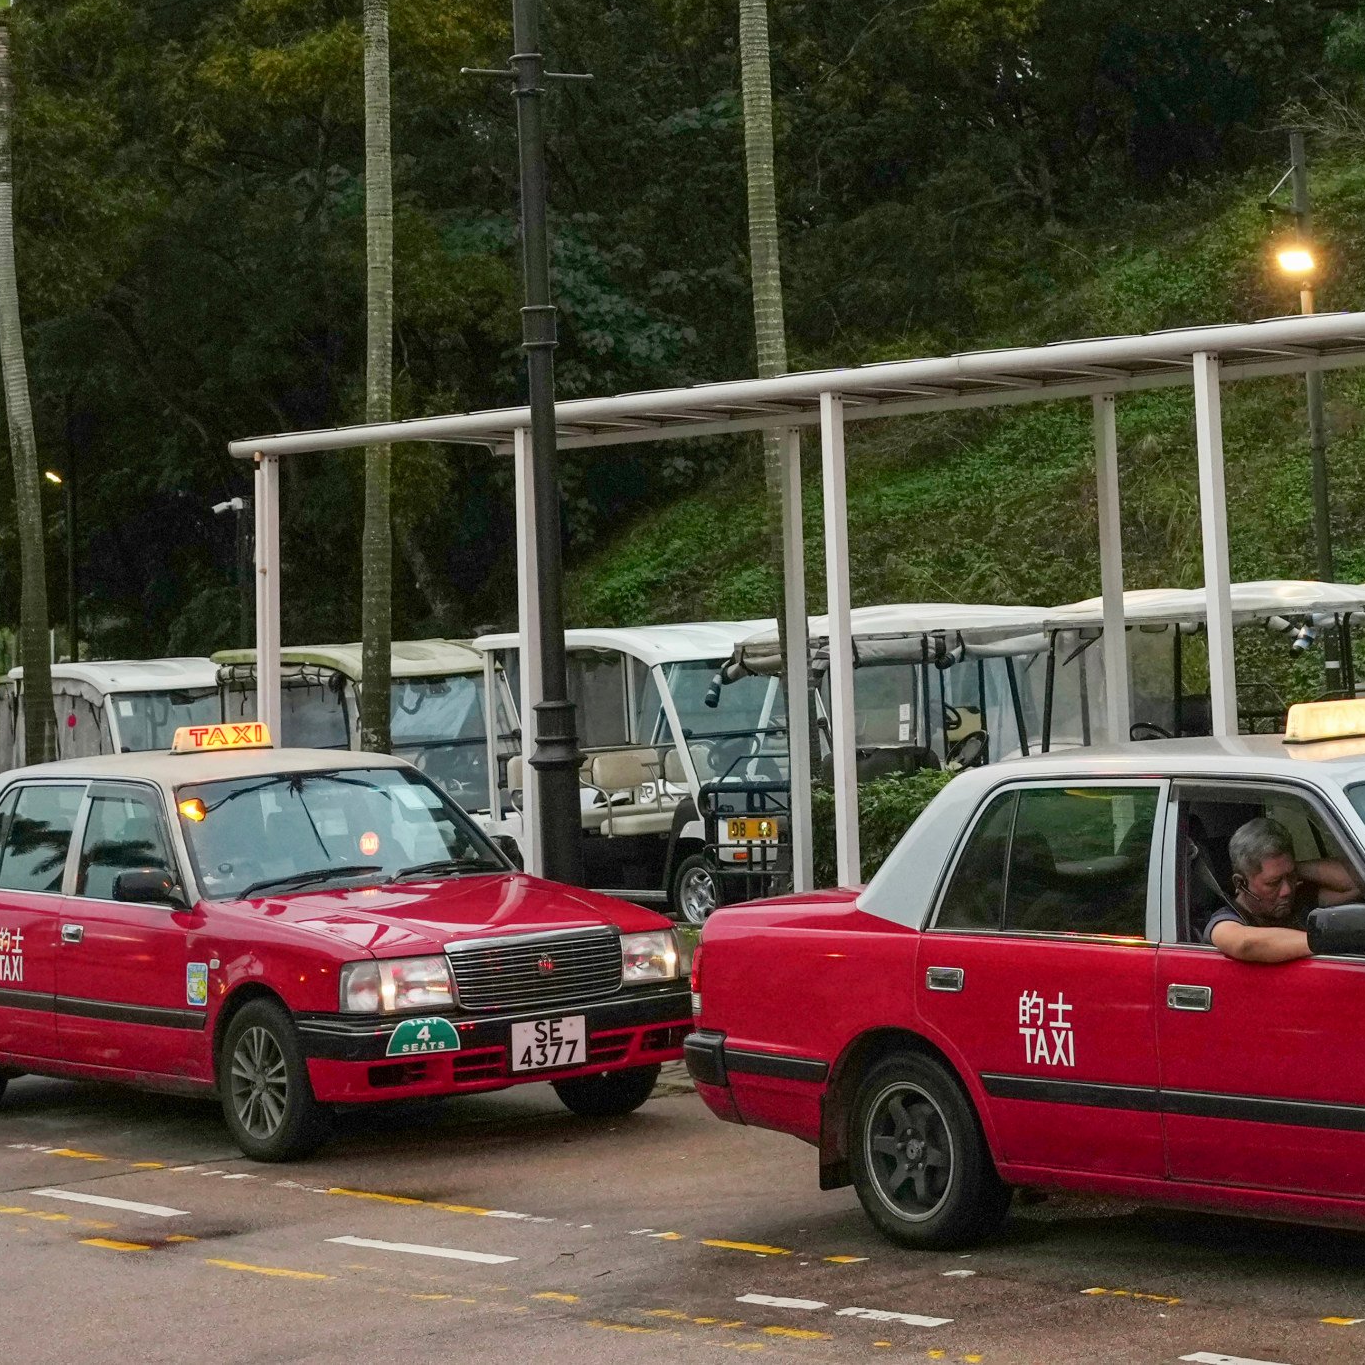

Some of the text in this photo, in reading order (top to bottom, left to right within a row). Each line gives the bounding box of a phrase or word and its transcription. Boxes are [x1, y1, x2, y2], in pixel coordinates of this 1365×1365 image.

[189, 725, 262, 747] TAXI
[732, 821, 746, 837] DB
[1018, 990, 1073, 1028] 的士
[416, 1025, 431, 1042] 4
[535, 1018, 564, 1043] SE
[402, 1041, 445, 1052] SEATS
[519, 1039, 580, 1068] 4377
[1018, 1027, 1075, 1067] TAXI
